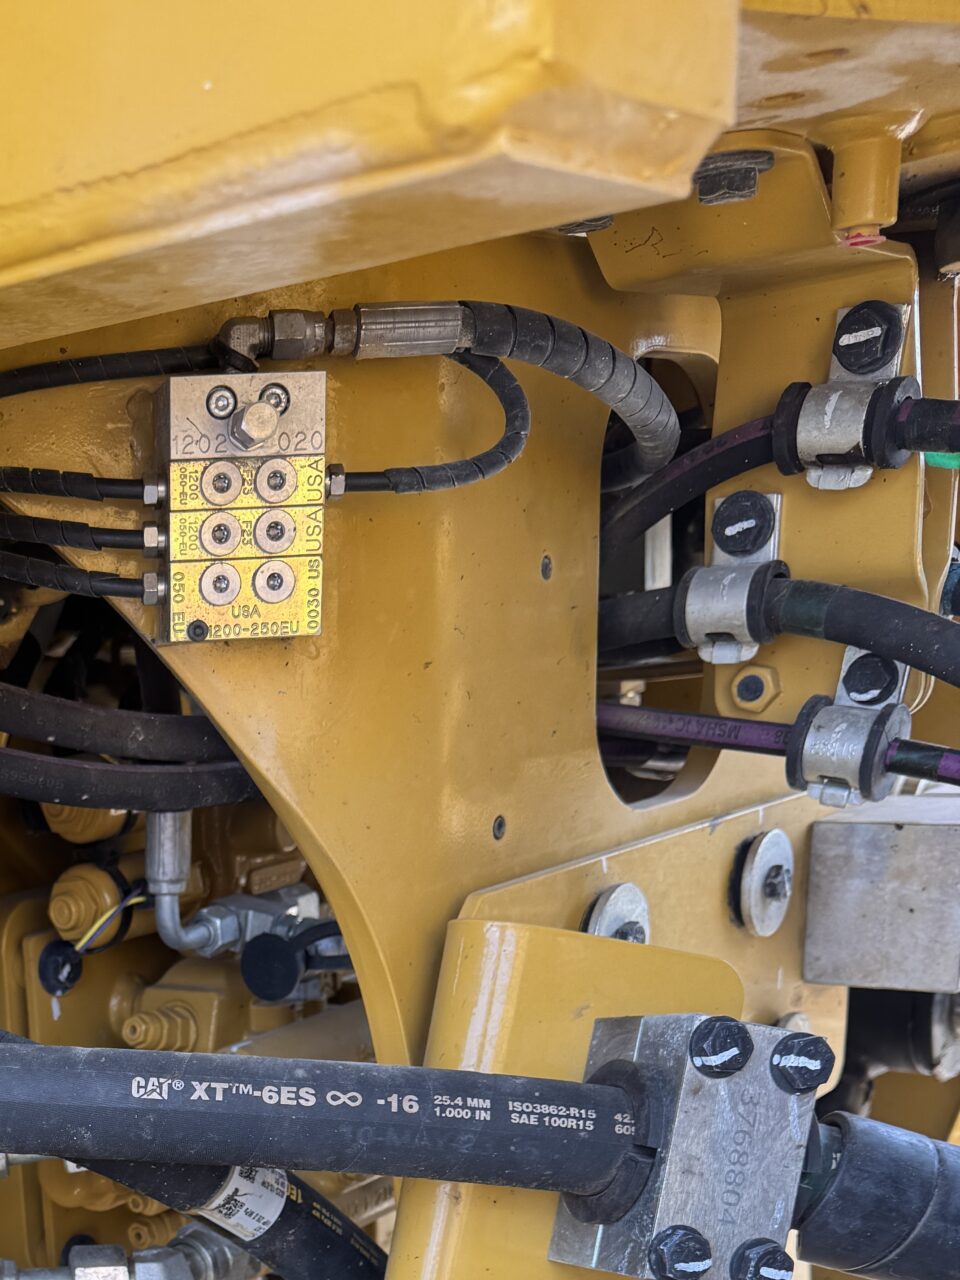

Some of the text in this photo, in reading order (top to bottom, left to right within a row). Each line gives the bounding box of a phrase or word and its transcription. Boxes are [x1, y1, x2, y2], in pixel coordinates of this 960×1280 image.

[307, 457, 324, 502] USA
[305, 508, 322, 552] USA
[308, 558, 321, 580] US
[172, 571, 186, 604] 050
[231, 604, 261, 619] USA
[377, 1093, 420, 1114] -16
[433, 1095, 491, 1109] 25.4 MM
[508, 1101, 597, 1119] ISO3862-R15
[434, 1107, 491, 1121] 1.000 IN
[510, 1113, 595, 1131] SAE 100R15
[719, 1088, 760, 1224] 3768804
